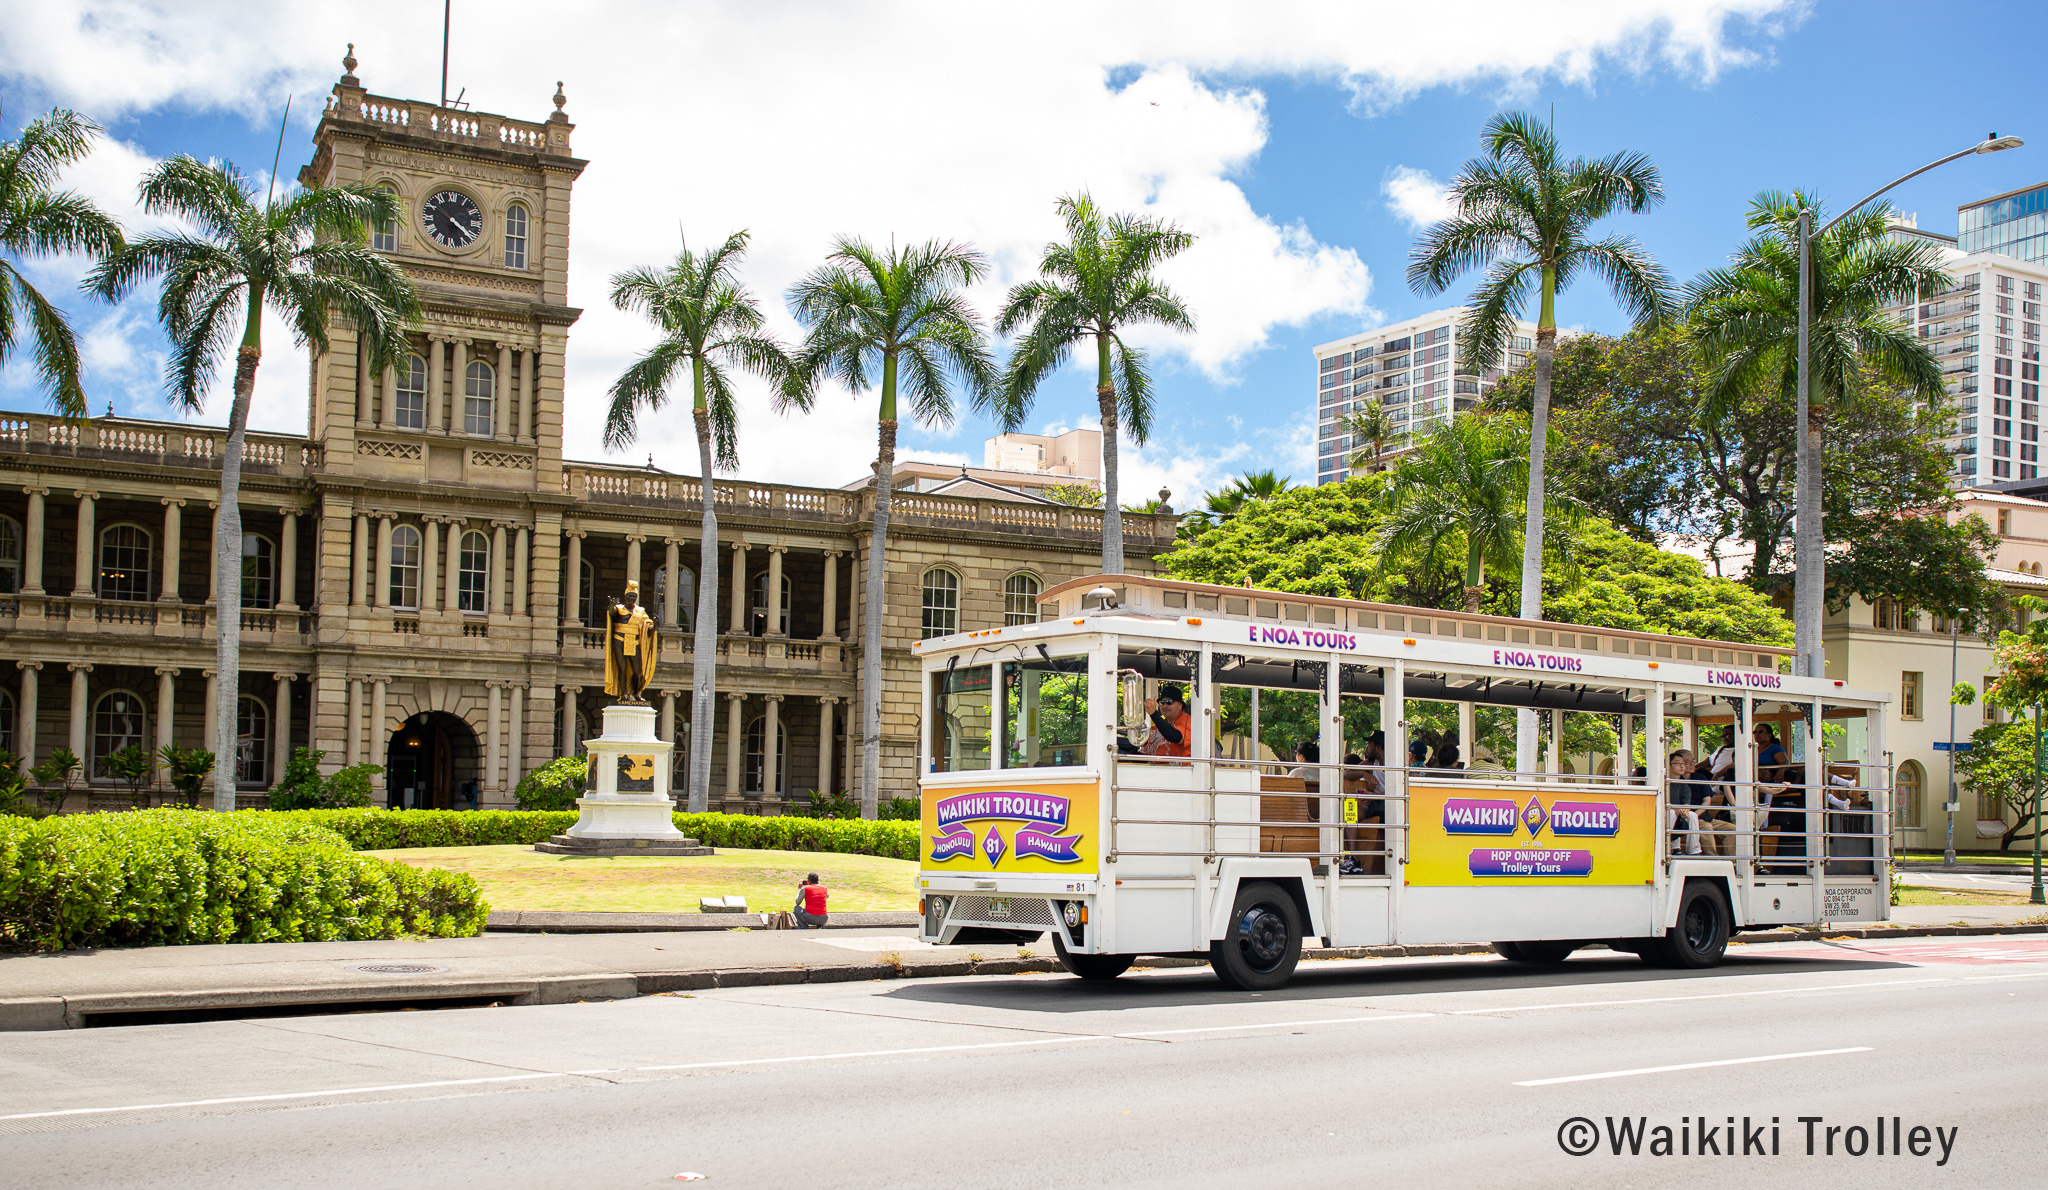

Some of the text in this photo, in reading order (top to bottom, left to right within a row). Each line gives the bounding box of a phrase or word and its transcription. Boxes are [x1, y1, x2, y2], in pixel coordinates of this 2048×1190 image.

[370, 152, 382, 161] UA
[385, 155, 407, 165] MAU
[410, 159, 422, 168] KE
[440, 163, 446, 171] O
[448, 164, 461, 174] KA
[464, 167, 487, 178] AINA
[490, 319, 503, 329] KA
[1249, 625, 1357, 650] E NOA TOURS
[1493, 650, 1582, 672] E NOA TOURS
[1707, 670, 1781, 689] E NOA TOURS
[939, 797, 1064, 822] WAIKIKI TROLLEY
[1446, 807, 1618, 829] WAIKIKI TROLLEY
[936, 836, 972, 853] HONOLULU
[986, 838, 999, 853] 81
[1027, 836, 1062, 854] HAWAII
[1491, 851, 1572, 862] HOP ON/HOP OFF
[1501, 862, 1561, 875] Trolley Tours
[1075, 882, 1085, 892] 81
